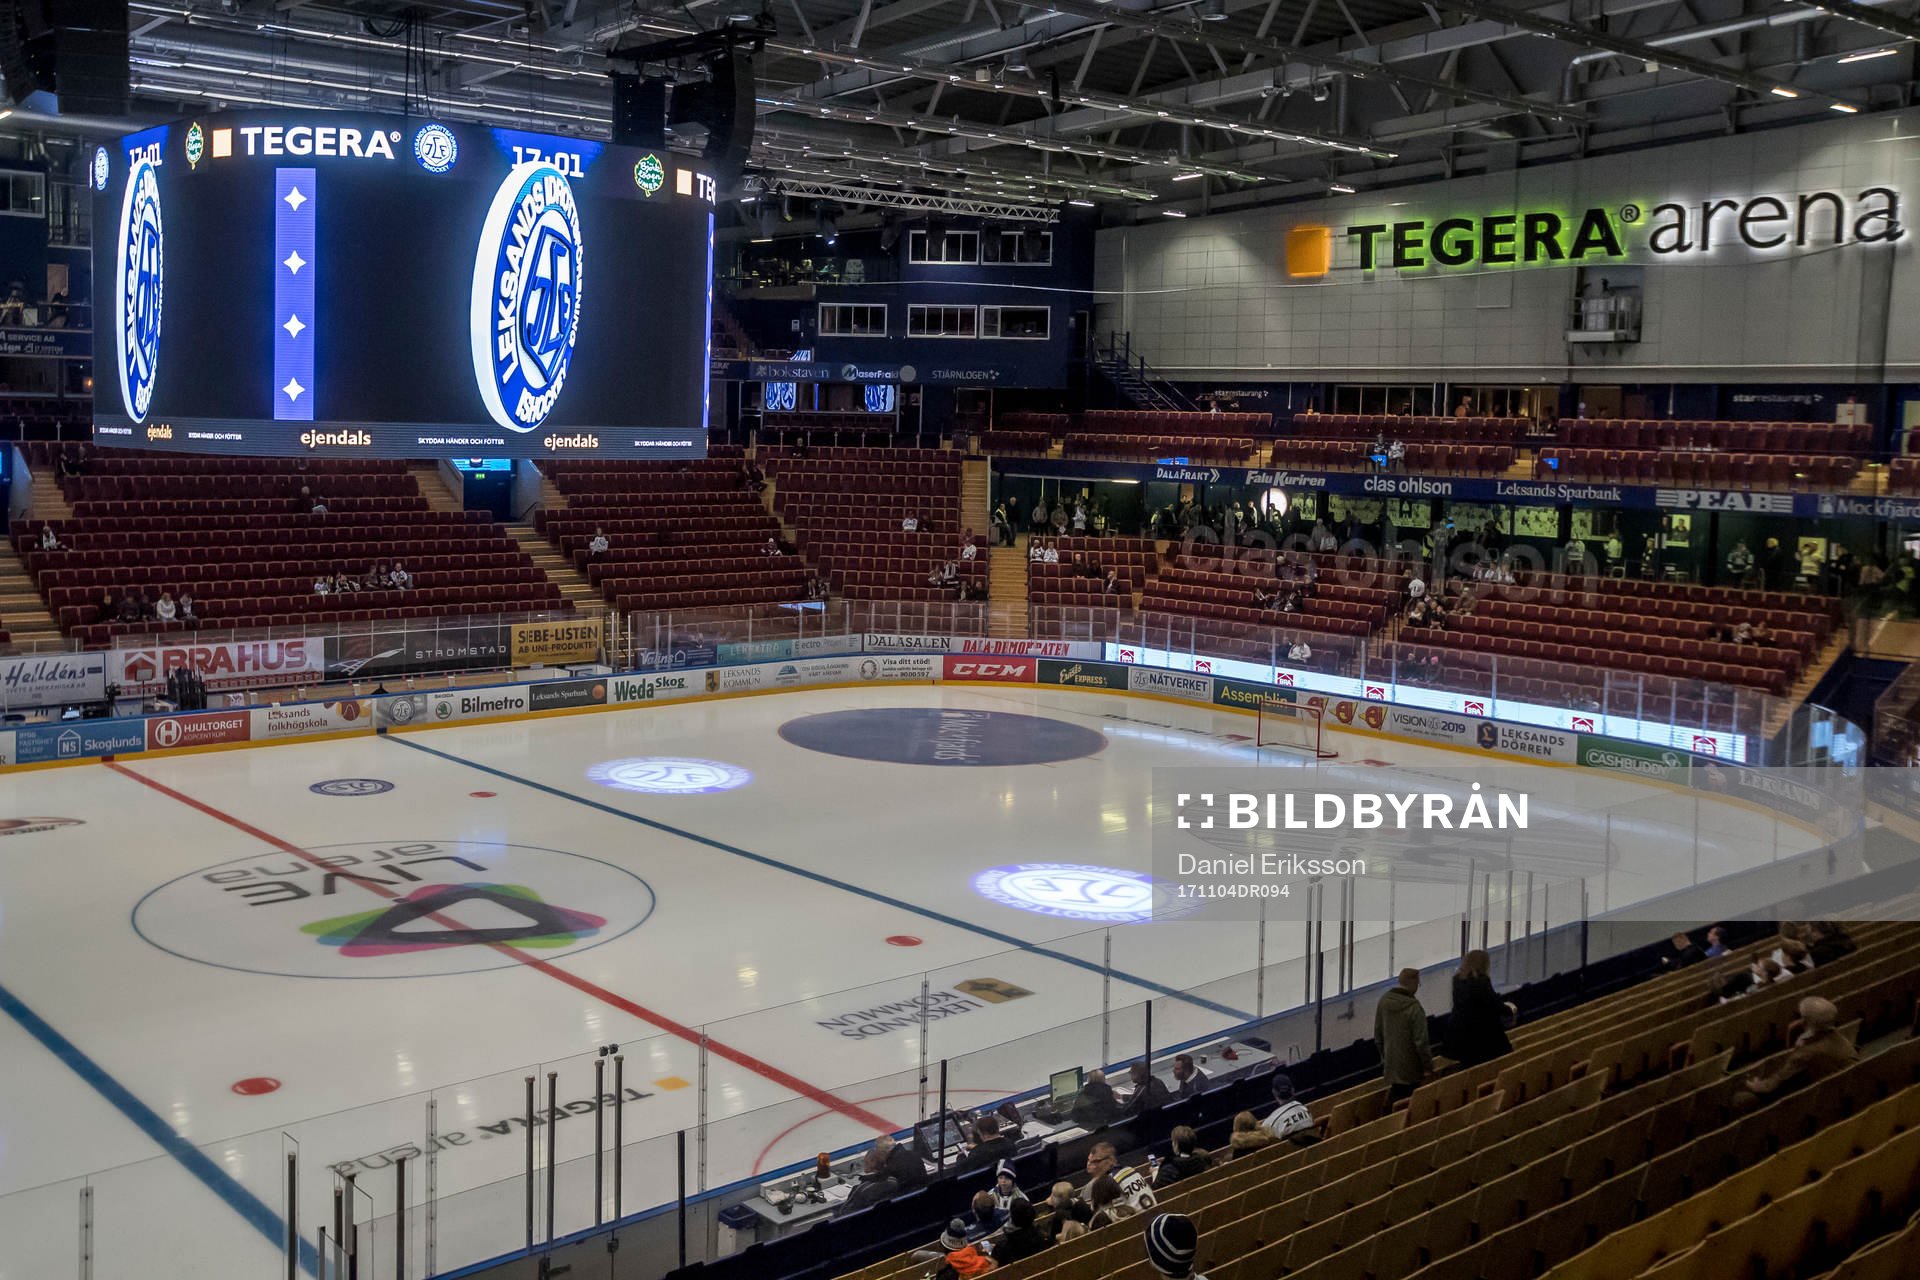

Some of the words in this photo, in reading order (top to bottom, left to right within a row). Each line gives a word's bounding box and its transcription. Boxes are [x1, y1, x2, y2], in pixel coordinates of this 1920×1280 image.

[1649, 186, 1906, 254] arena
[147, 424, 173, 441] ejendals
[300, 429, 372, 448] ejendals
[544, 435, 599, 451] ejendals
[1364, 476, 1396, 492] clas
[1398, 477, 1452, 495] ohlson
[1496, 481, 1557, 498] Leksands
[1557, 484, 1622, 502] Sparbank
[1675, 489, 1774, 513] PEAB
[794, 639, 821, 649] Eectro
[868, 634, 951, 648] DALASALEN
[162, 640, 307, 676] BRAHUS
[724, 667, 761, 678] LEKSANDS
[952, 663, 1027, 677] CCM
[724, 677, 760, 688] KOMMUN
[1075, 674, 1103, 685] EXPRESS
[1149, 673, 1208, 692] NÄTVERKET
[532, 692, 560, 702] Leksands
[560, 689, 588, 700] Sparbank
[614, 678, 654, 701] Weda
[655, 676, 685, 688] Skog
[1221, 686, 1288, 708] Assemblin
[461, 697, 524, 713] Bilmetro
[268, 708, 311, 720] Lksands
[184, 719, 244, 732] HJULTORGET
[268, 718, 328, 732] folkhögskola
[1392, 712, 1427, 727] VISION
[1441, 720, 1466, 734] 2019
[84, 736, 142, 751] Skoglunds
[1501, 728, 1565, 746] LEKSANDS
[62, 741, 76, 753] NS
[1501, 739, 1552, 756] DÖRREN
[1587, 750, 1668, 777] CASHBUDDY
[816, 991, 959, 1030] KOMMUN
[841, 1000, 984, 1041] LEKSANDS
